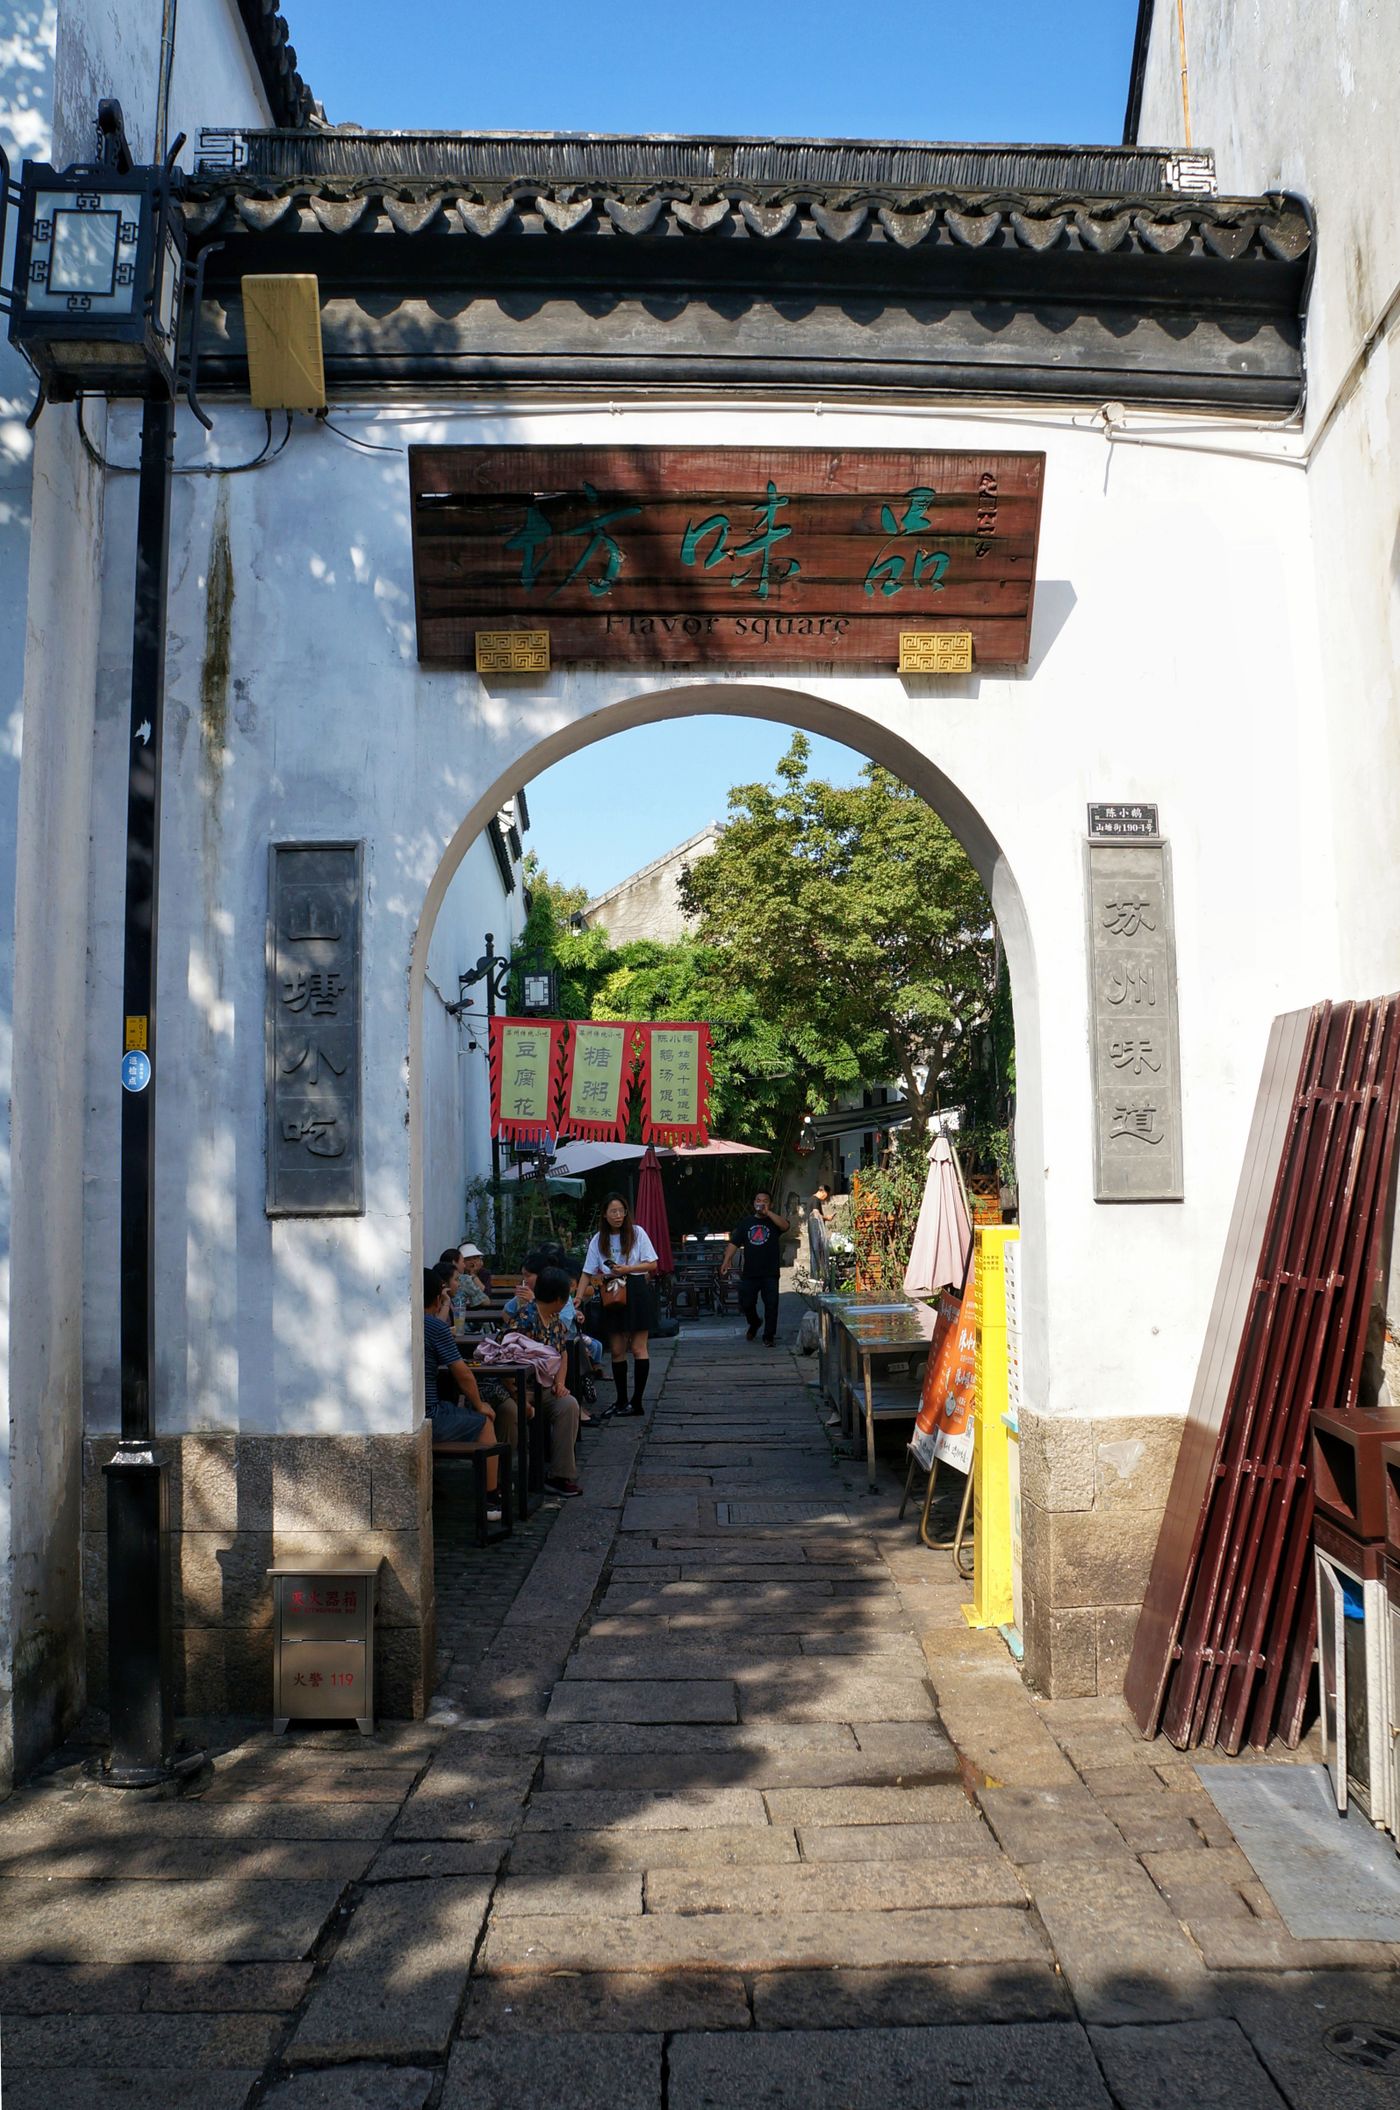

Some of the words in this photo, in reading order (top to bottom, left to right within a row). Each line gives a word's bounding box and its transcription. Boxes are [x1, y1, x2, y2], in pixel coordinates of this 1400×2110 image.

[605, 614, 719, 636] Flavor
[735, 617, 850, 646] square
[282, 896, 347, 1158] 山塘小吃
[1102, 898, 1165, 1145] 苏州味道
[513, 1041, 538, 1117] 豆腐花
[582, 1046, 612, 1102] 糖粥
[293, 1672, 324, 1688] 火警
[330, 1672, 354, 1688] 119
